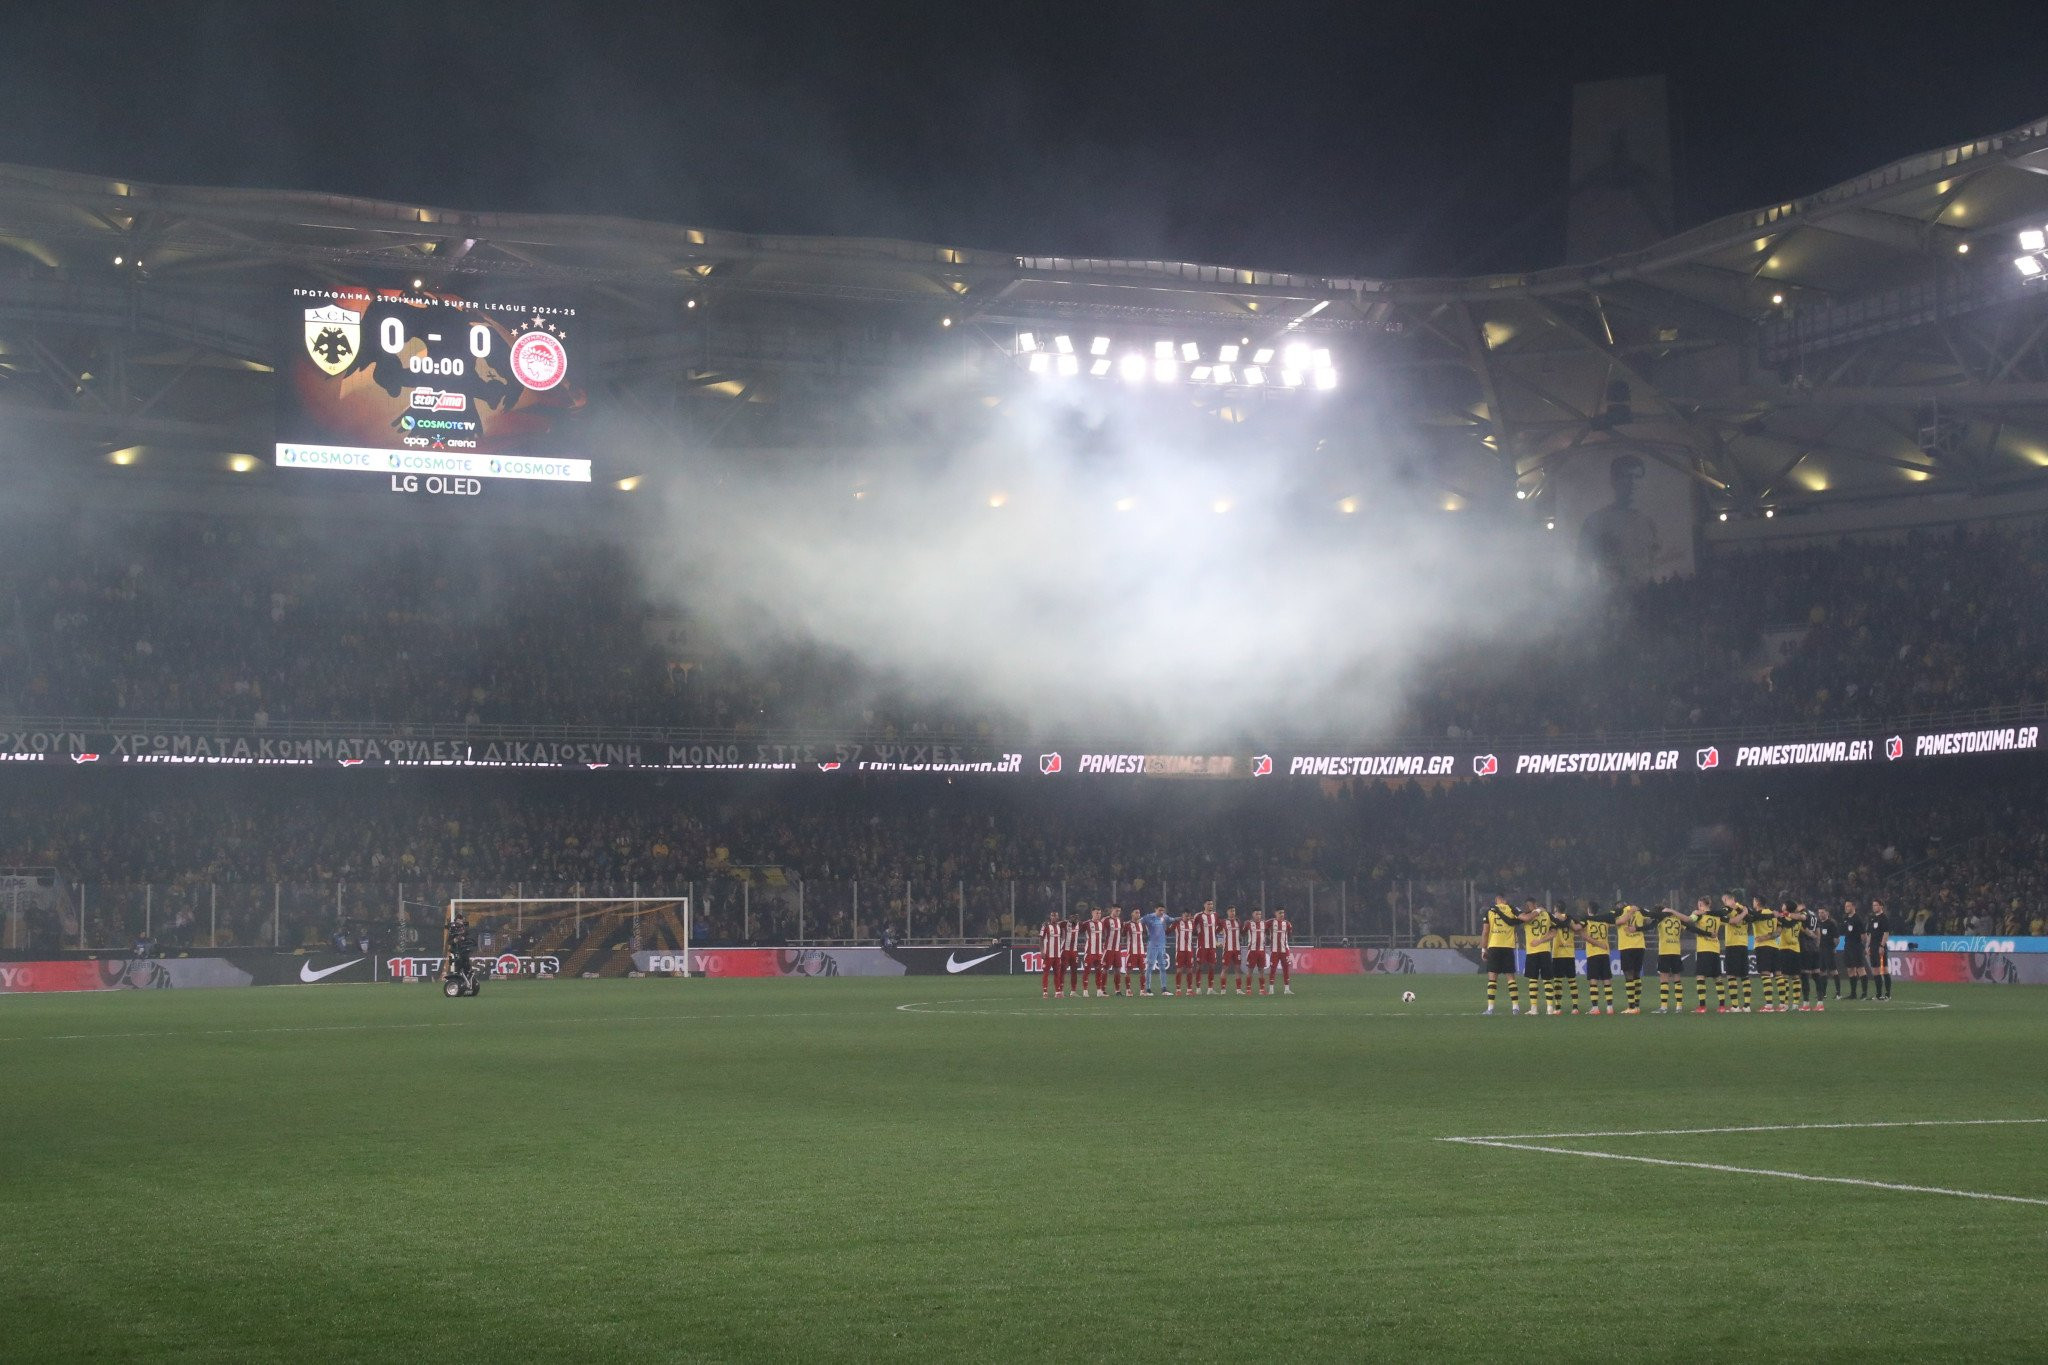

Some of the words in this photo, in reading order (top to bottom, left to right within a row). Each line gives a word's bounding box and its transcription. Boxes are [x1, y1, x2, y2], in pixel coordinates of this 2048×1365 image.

[293, 288, 371, 301] ΠΡΩΤΑΘΛΗΜΑ
[377, 294, 439, 306] STOIXIMAN
[444, 299, 479, 309] SUPER
[485, 303, 527, 313] LEAGUE
[532, 306, 576, 316] 2024-25
[381, 317, 405, 354] 0
[470, 325, 491, 358] 0
[410, 355, 464, 376] 00:00
[403, 436, 429, 448] opap
[447, 439, 477, 449] arena
[391, 474, 418, 493] LG
[426, 476, 482, 496] OLED
[1916, 725, 2039, 757] PAMESTOIXIMA.GR
[484, 742, 641, 764] ΔΙΚΑΙΟΣΥΝΗ
[668, 744, 739, 764] ΜΟΝΟ
[1516, 750, 1680, 774] PAMESTOIXIMA.GR
[1289, 755, 1455, 776] PAMESTOIXIMA.GR
[1531, 918, 1547, 937] 26
[1590, 923, 1608, 940] 20
[1664, 919, 1681, 937] 23
[387, 953, 560, 978] 11TESPORTS
